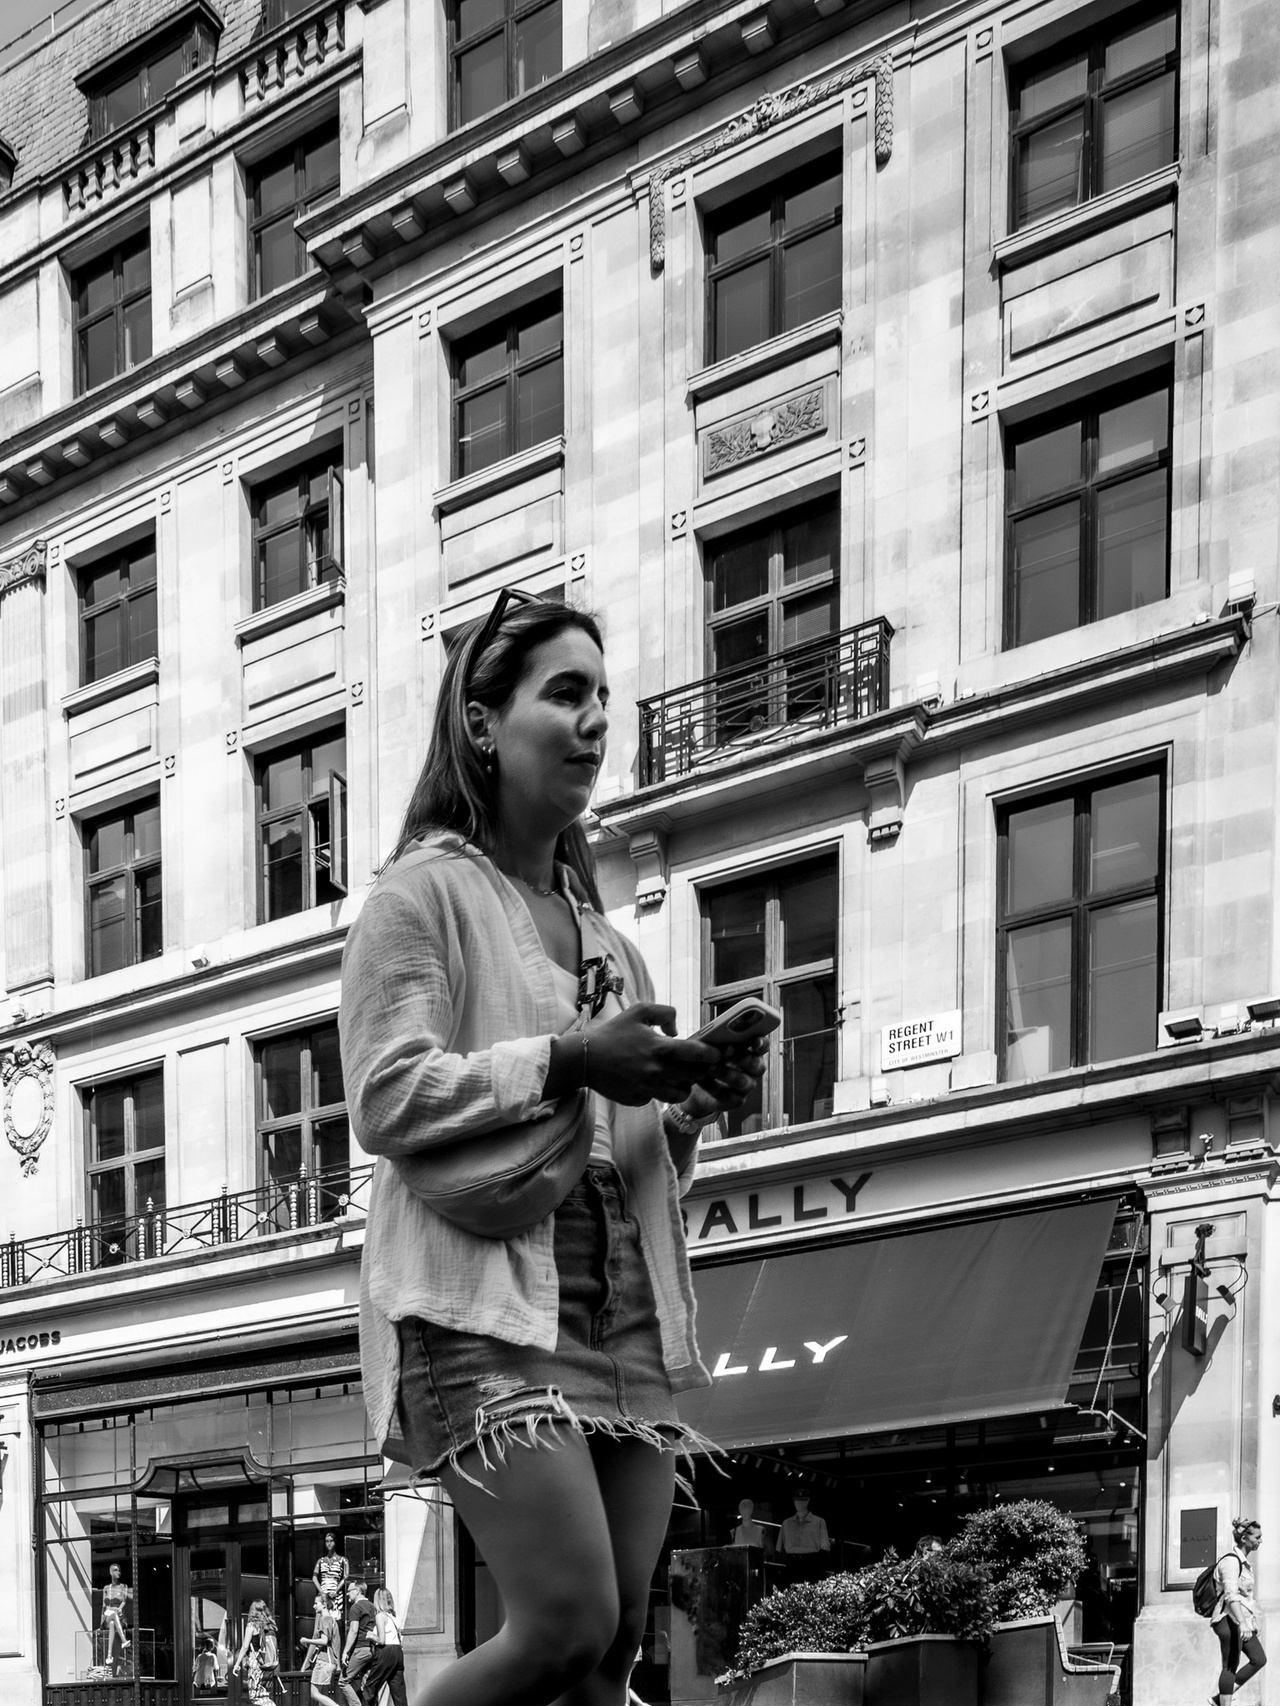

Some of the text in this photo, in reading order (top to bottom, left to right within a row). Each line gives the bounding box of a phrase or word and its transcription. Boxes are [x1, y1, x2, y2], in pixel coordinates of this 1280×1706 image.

[889, 1020, 934, 1040] REGENT
[888, 1030, 953, 1054] STREET W1
